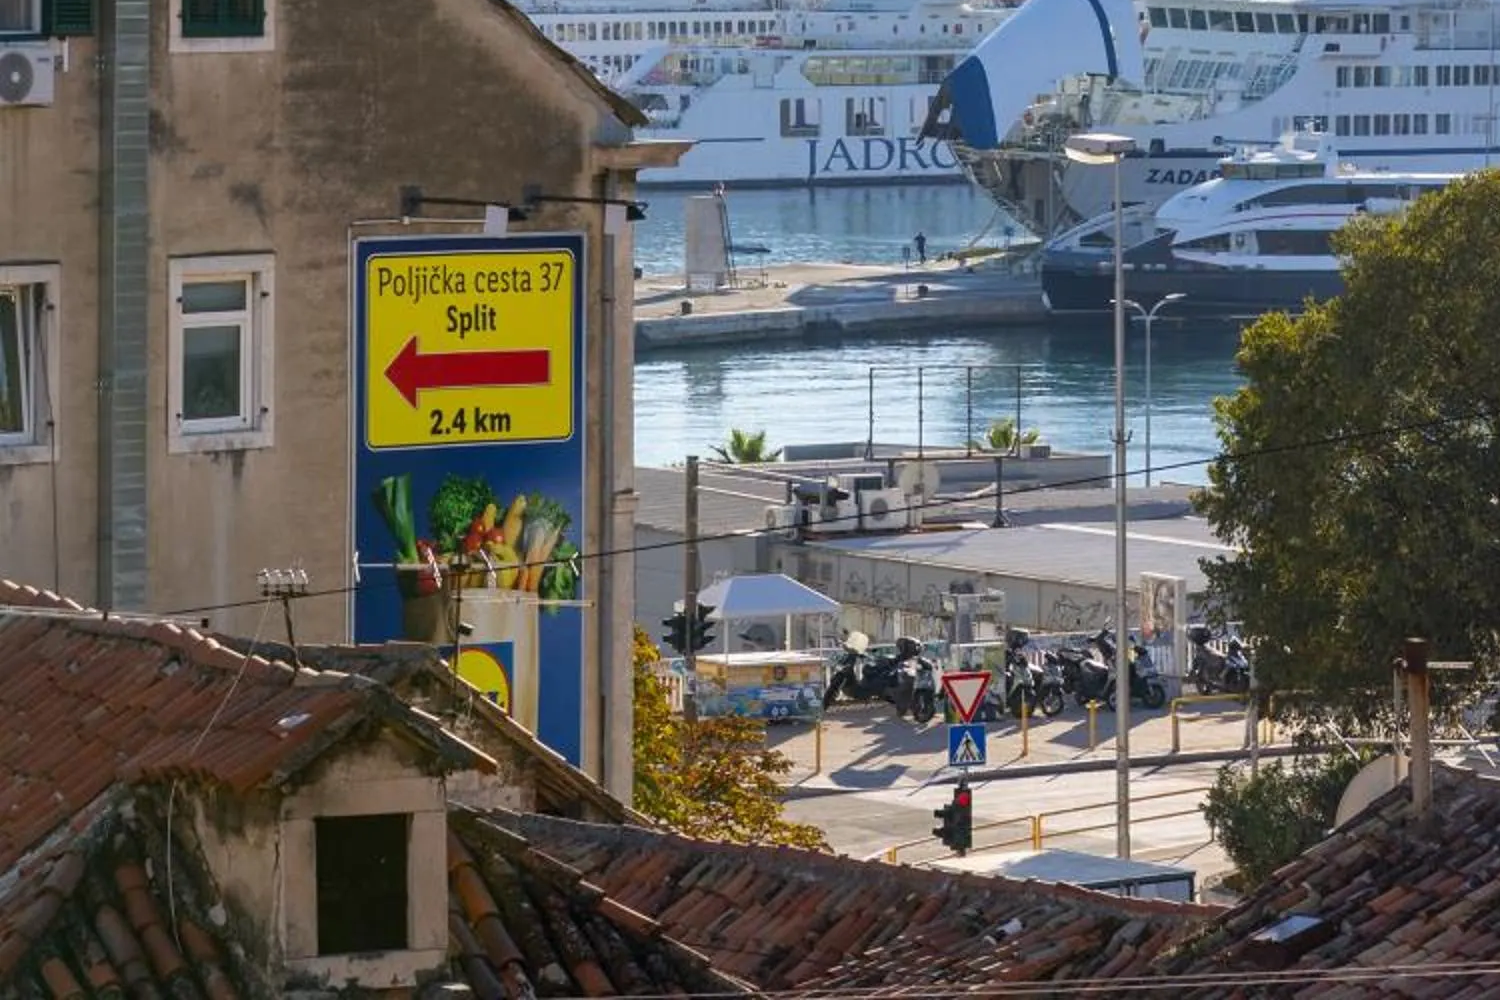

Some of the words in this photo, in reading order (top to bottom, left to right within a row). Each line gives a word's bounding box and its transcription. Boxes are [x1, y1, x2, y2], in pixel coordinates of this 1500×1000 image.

[378, 264, 466, 304] Poljička
[475, 267, 531, 294] cesta
[540, 262, 565, 293] 37
[447, 303, 497, 340] Split
[430, 407, 467, 435] 2.4
[474, 405, 511, 433] km
